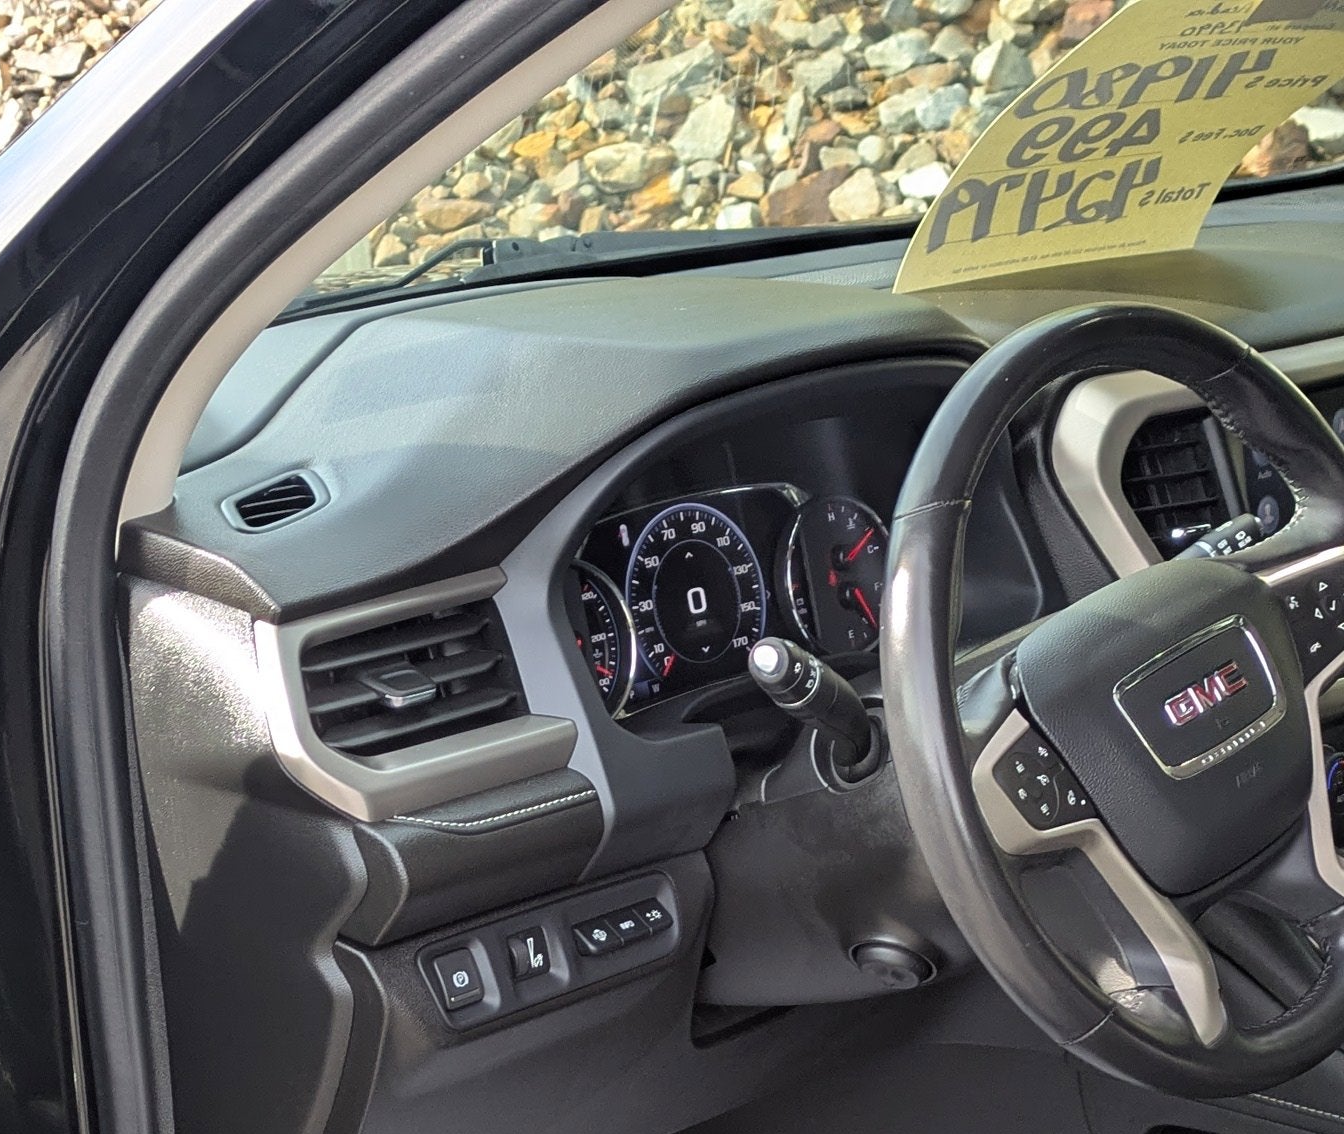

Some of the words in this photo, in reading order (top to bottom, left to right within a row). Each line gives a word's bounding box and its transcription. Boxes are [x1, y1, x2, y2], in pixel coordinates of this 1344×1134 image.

[690, 521, 706, 534] 90
[661, 528, 676, 541] 70
[644, 555, 660, 569] 50
[639, 599, 653, 612] 30
[686, 586, 707, 614] 0
[740, 600, 756, 612] 150
[591, 633, 606, 643] 200
[733, 635, 749, 648] 170
[653, 643, 665, 655] 10
[1164, 661, 1249, 727] GMC
